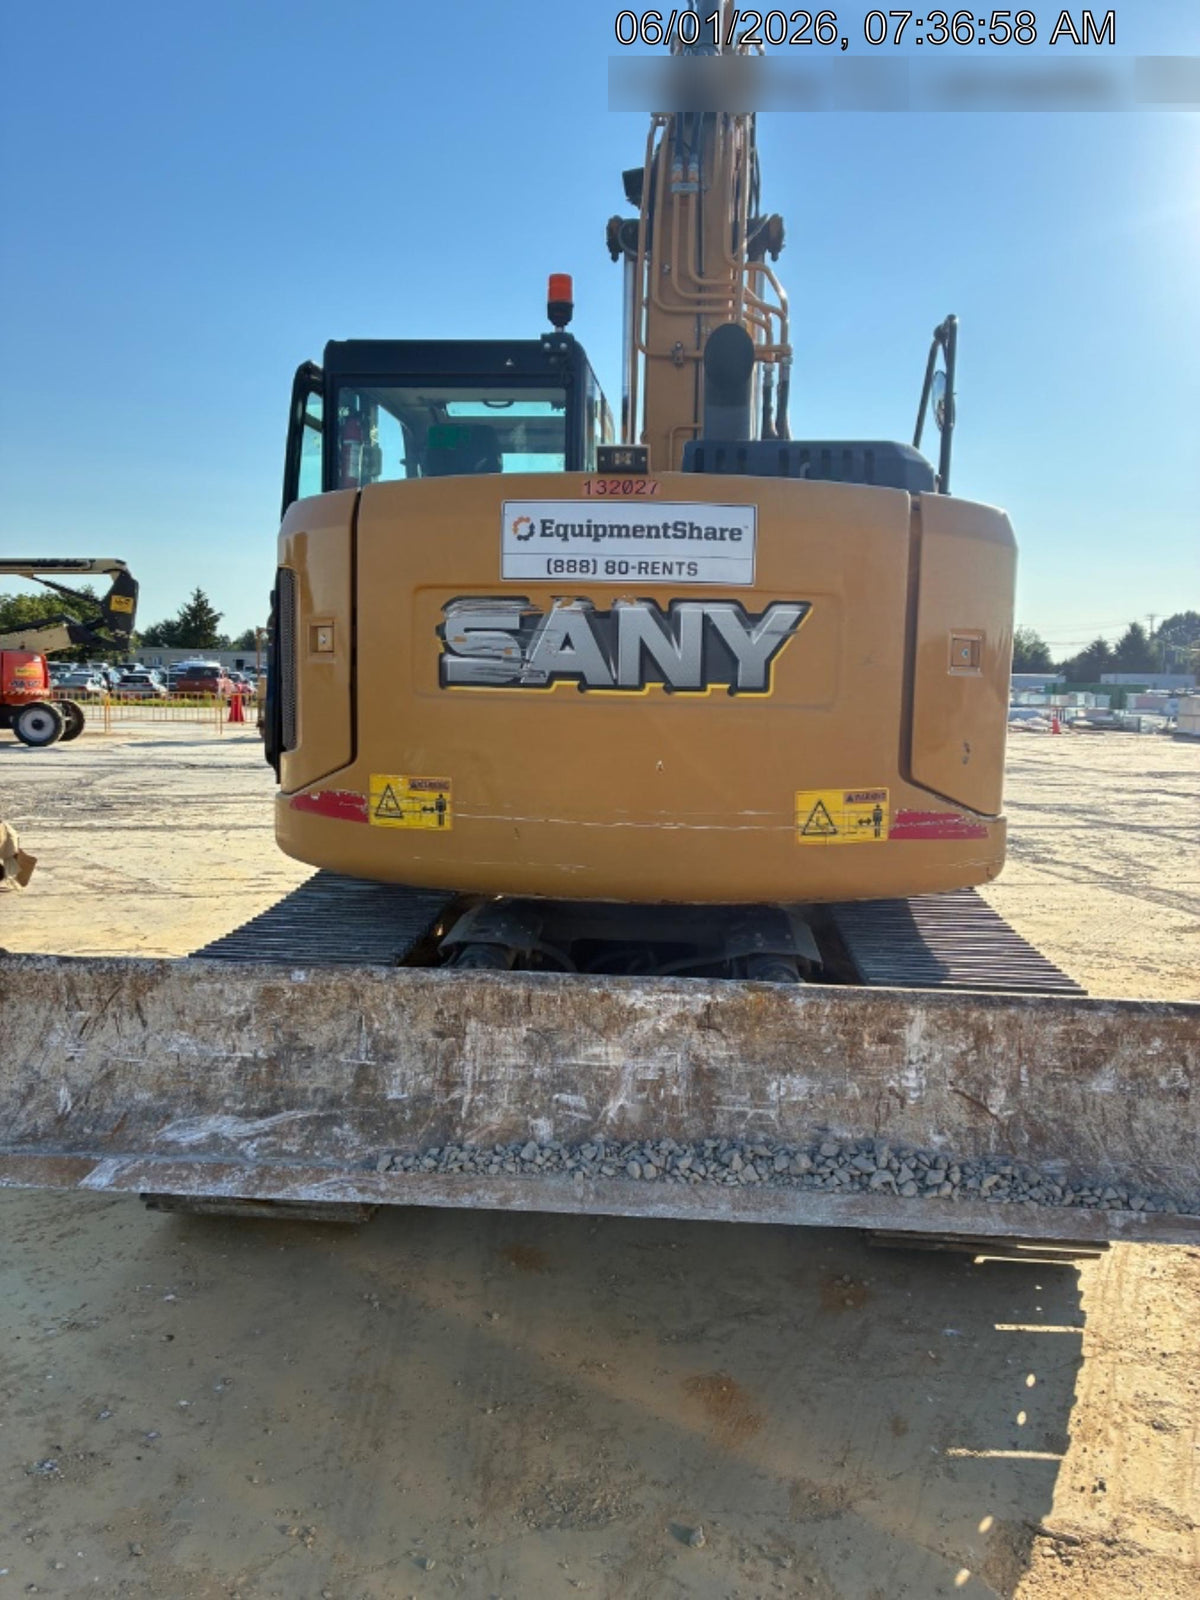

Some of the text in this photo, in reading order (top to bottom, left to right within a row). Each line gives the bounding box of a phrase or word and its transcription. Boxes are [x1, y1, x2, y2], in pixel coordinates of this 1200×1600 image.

[584, 479, 660, 496] 132027
[540, 518, 743, 542] EquipmentShare
[547, 558, 698, 577] (888) 80-RENTS
[438, 596, 811, 695] SANY
